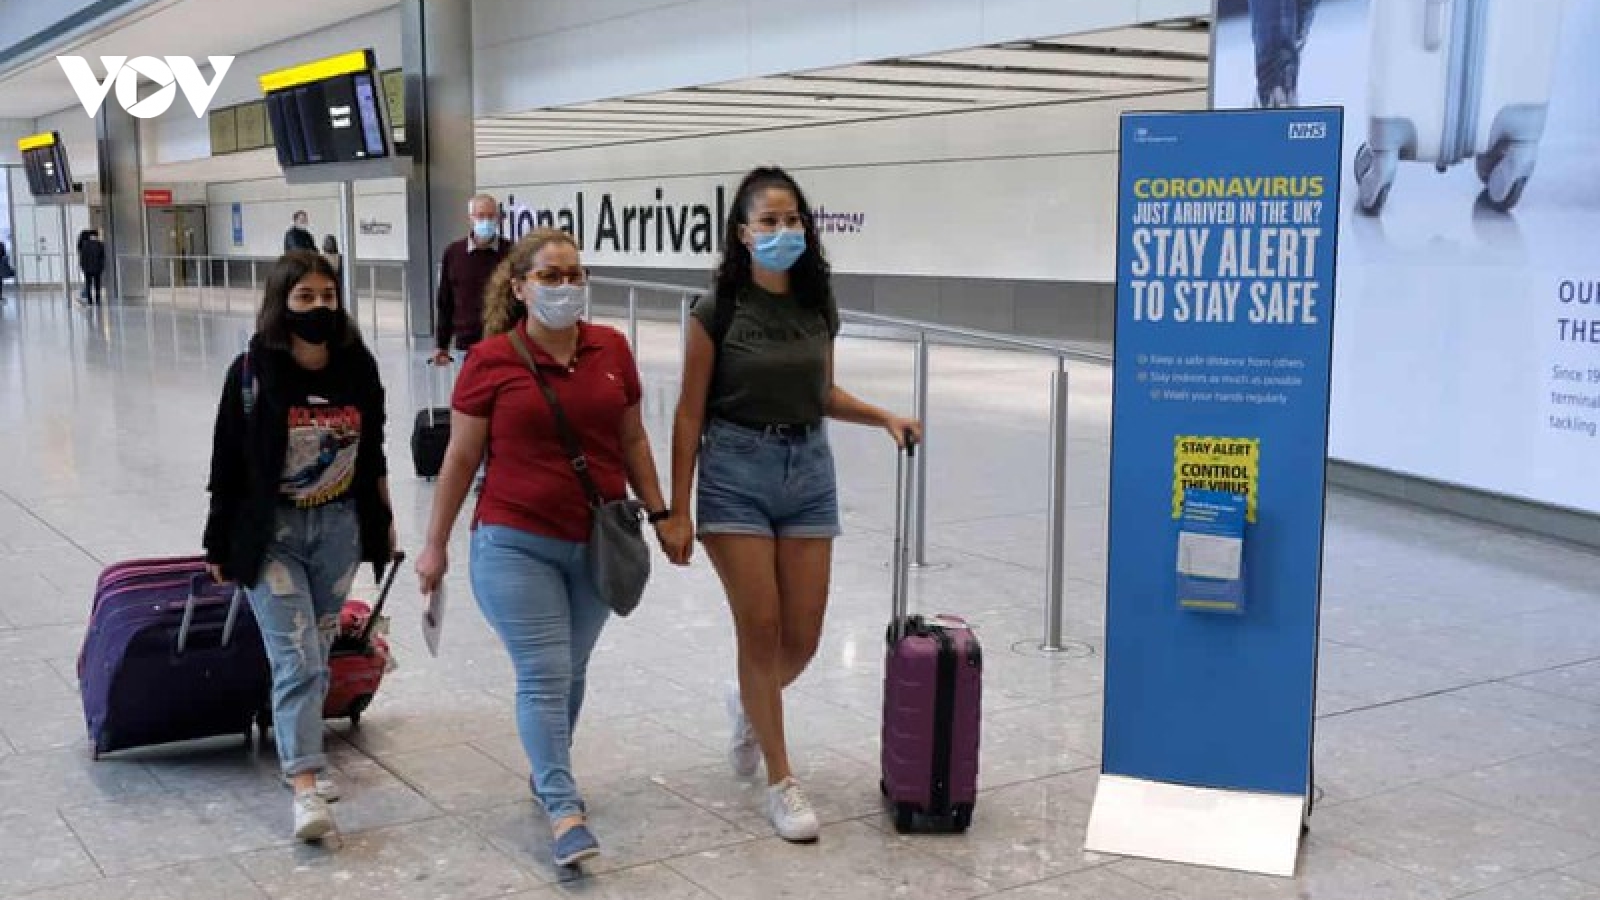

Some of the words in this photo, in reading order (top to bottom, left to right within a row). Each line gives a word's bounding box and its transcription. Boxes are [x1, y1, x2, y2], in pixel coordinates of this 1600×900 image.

[1290, 123, 1325, 138] NHS
[1134, 176, 1324, 198] CORONAVIRUS
[1133, 202, 1170, 225] JUST
[1174, 202, 1235, 225] ARRIVED
[1240, 202, 1256, 225] IN
[1260, 202, 1289, 225] THE
[1293, 202, 1322, 225] UK?
[1131, 228, 1209, 277] STAY
[1218, 228, 1321, 277] ALERT
[1130, 280, 1165, 321] TO
[1174, 281, 1240, 323] STAY
[1248, 281, 1320, 324] SAFE
[1150, 354, 1174, 367] Keep
[1185, 354, 1204, 366] safe
[1206, 355, 1245, 367] distance
[1248, 356, 1271, 367] from
[1273, 357, 1305, 369] others
[1150, 371, 1171, 384] Stay
[1222, 373, 1249, 384] much
[1264, 374, 1303, 386] possible
[1552, 365, 1582, 382] Since
[1164, 390, 1189, 402] Wash
[1192, 392, 1213, 403] your
[1214, 391, 1245, 403] hands
[1246, 392, 1288, 405] regularly
[1549, 415, 1597, 437] tackling
[1181, 441, 1211, 455] STAY
[1214, 443, 1251, 456] ALERT
[1181, 463, 1248, 478] CONTROL
